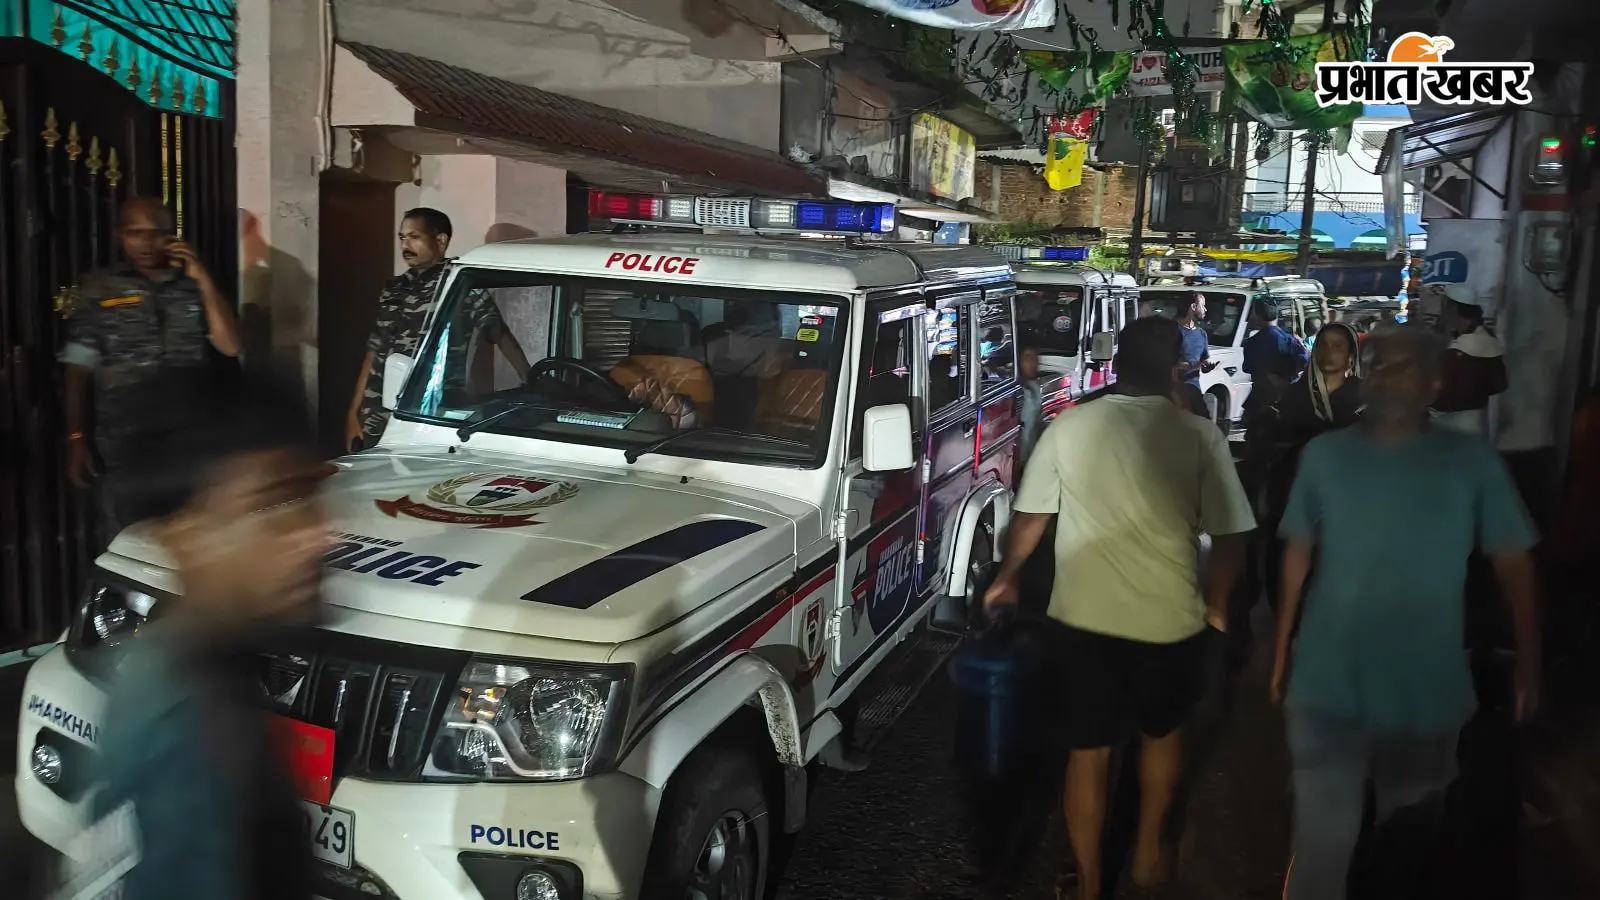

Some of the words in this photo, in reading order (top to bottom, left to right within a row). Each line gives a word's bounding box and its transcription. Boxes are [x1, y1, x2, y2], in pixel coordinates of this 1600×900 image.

[604, 252, 701, 275] POLICE
[323, 541, 483, 587] OLICE
[873, 540, 914, 608] POLICE
[28, 694, 99, 744] JHARKHA
[313, 816, 347, 854] 49
[470, 824, 560, 851] POLICE
